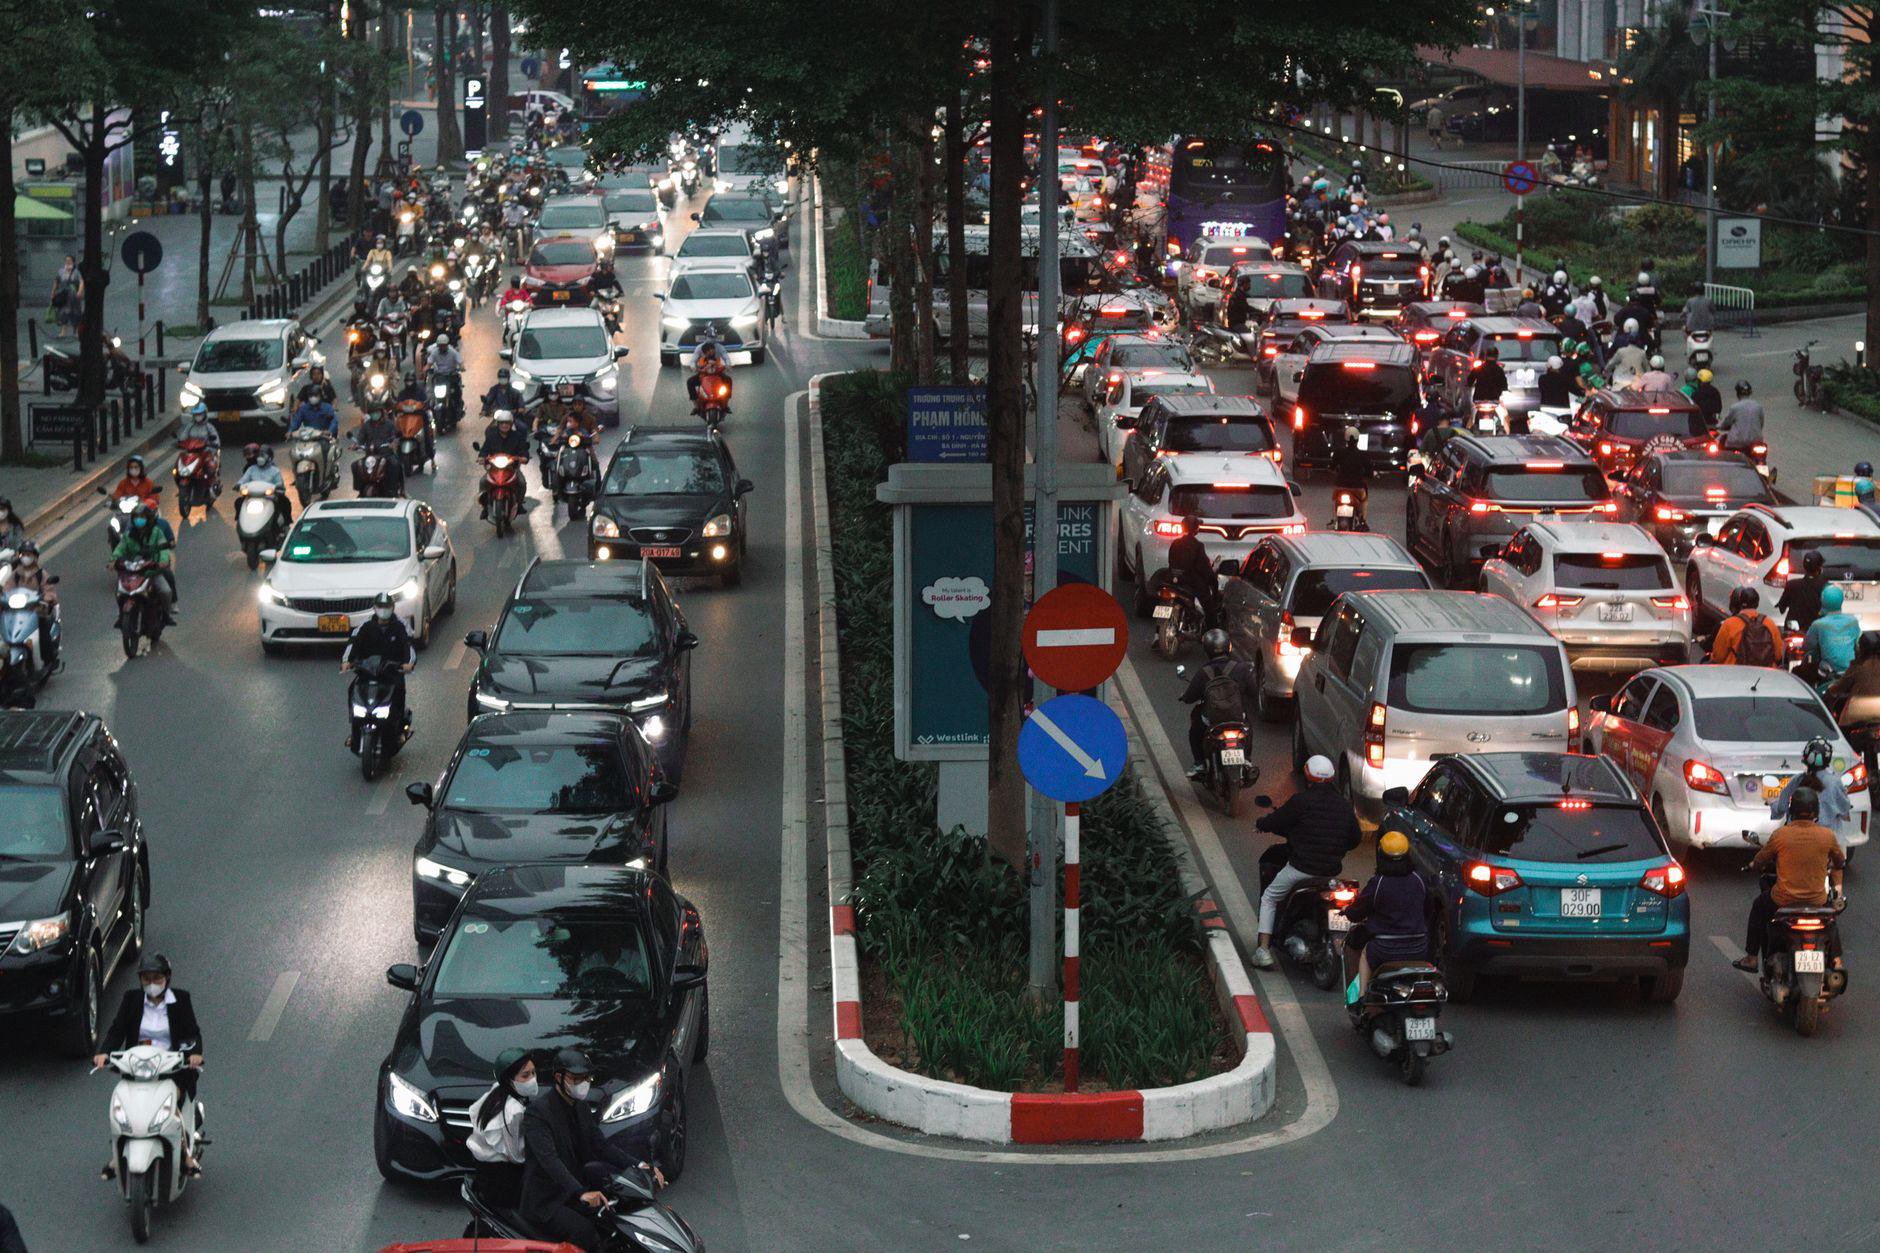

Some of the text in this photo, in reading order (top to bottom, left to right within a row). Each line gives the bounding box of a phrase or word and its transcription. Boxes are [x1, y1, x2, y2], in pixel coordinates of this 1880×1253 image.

[468, 80, 481, 97] P
[912, 411, 950, 430] PHẠM
[931, 594, 984, 603] Roller Skating
[936, 732, 979, 742] Westlink
[1570, 889, 1592, 902] 30F
[1562, 903, 1600, 916] 029.00
